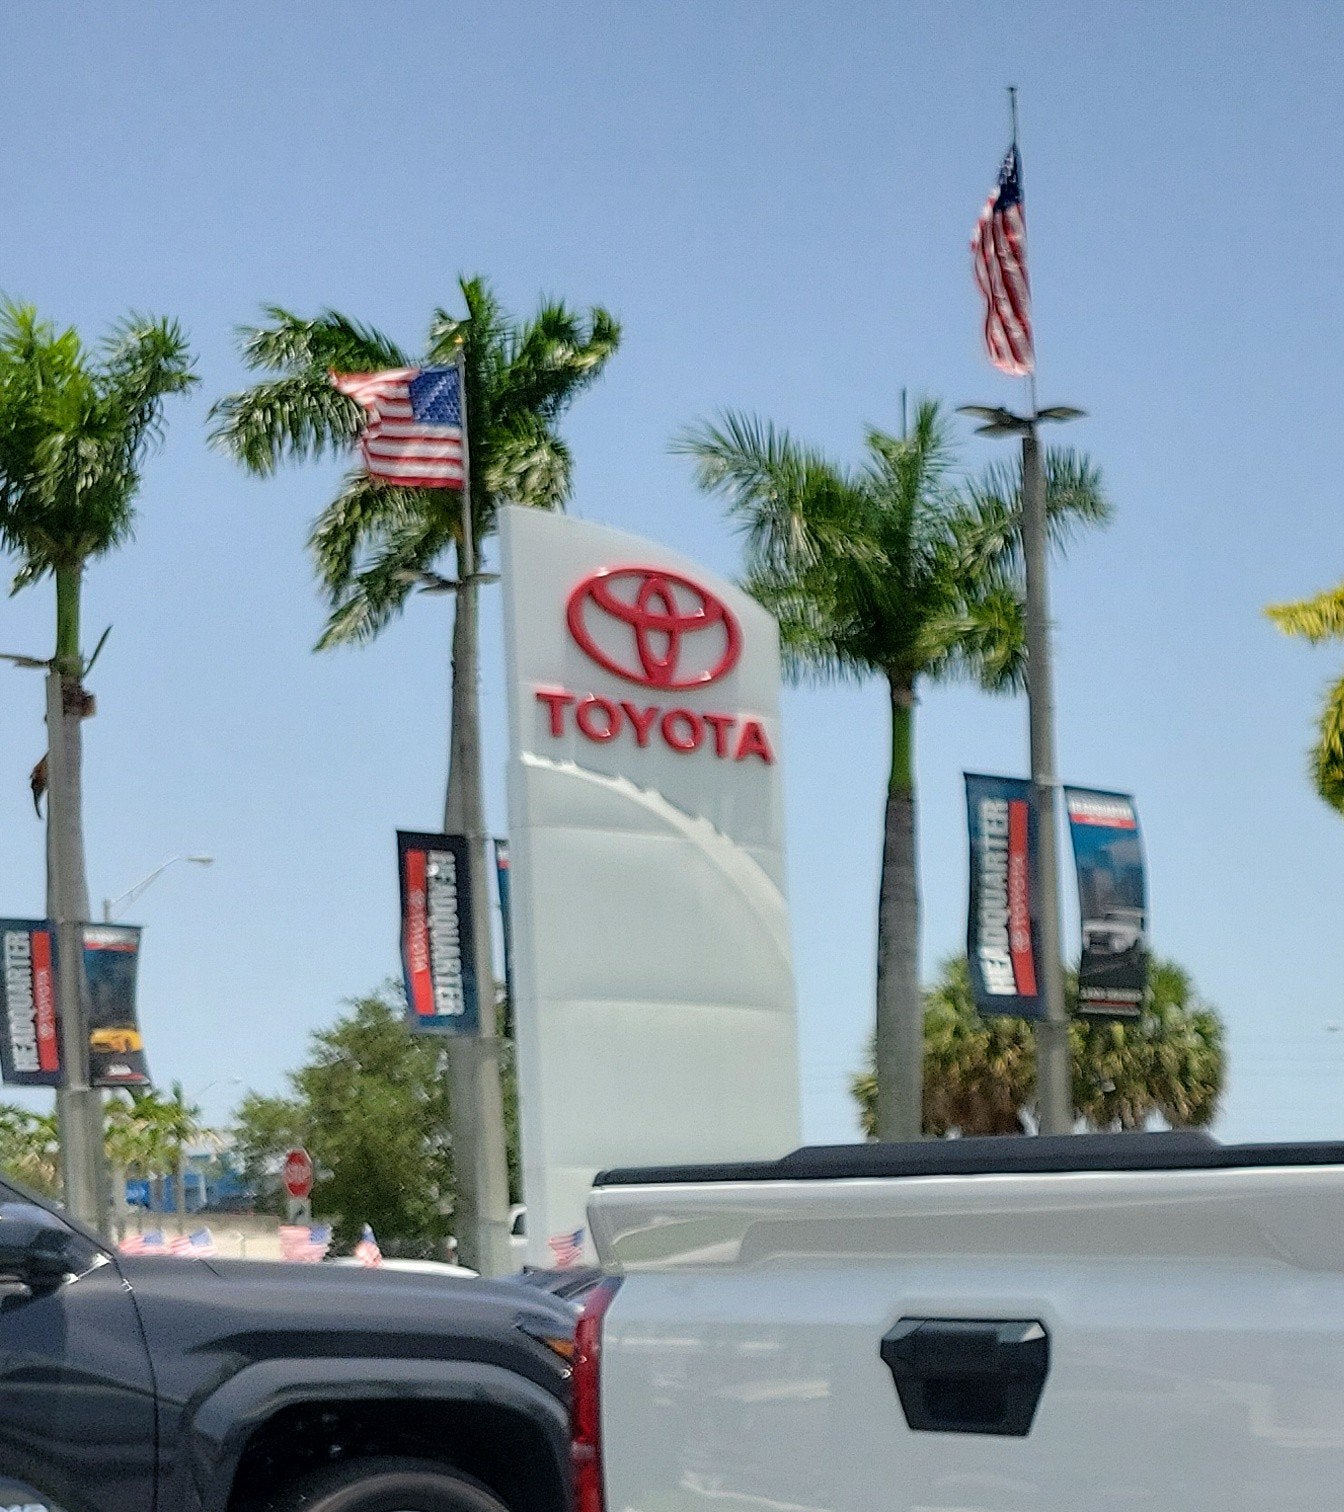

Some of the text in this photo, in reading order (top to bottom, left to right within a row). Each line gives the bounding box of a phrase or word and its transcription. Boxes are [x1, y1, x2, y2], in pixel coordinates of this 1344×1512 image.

[536, 691, 774, 765] TOYOTA
[428, 850, 465, 1015] HEADQUARTER
[979, 800, 1018, 995] HEADQUARTER
[4, 930, 40, 1072] HEADQUARTER
